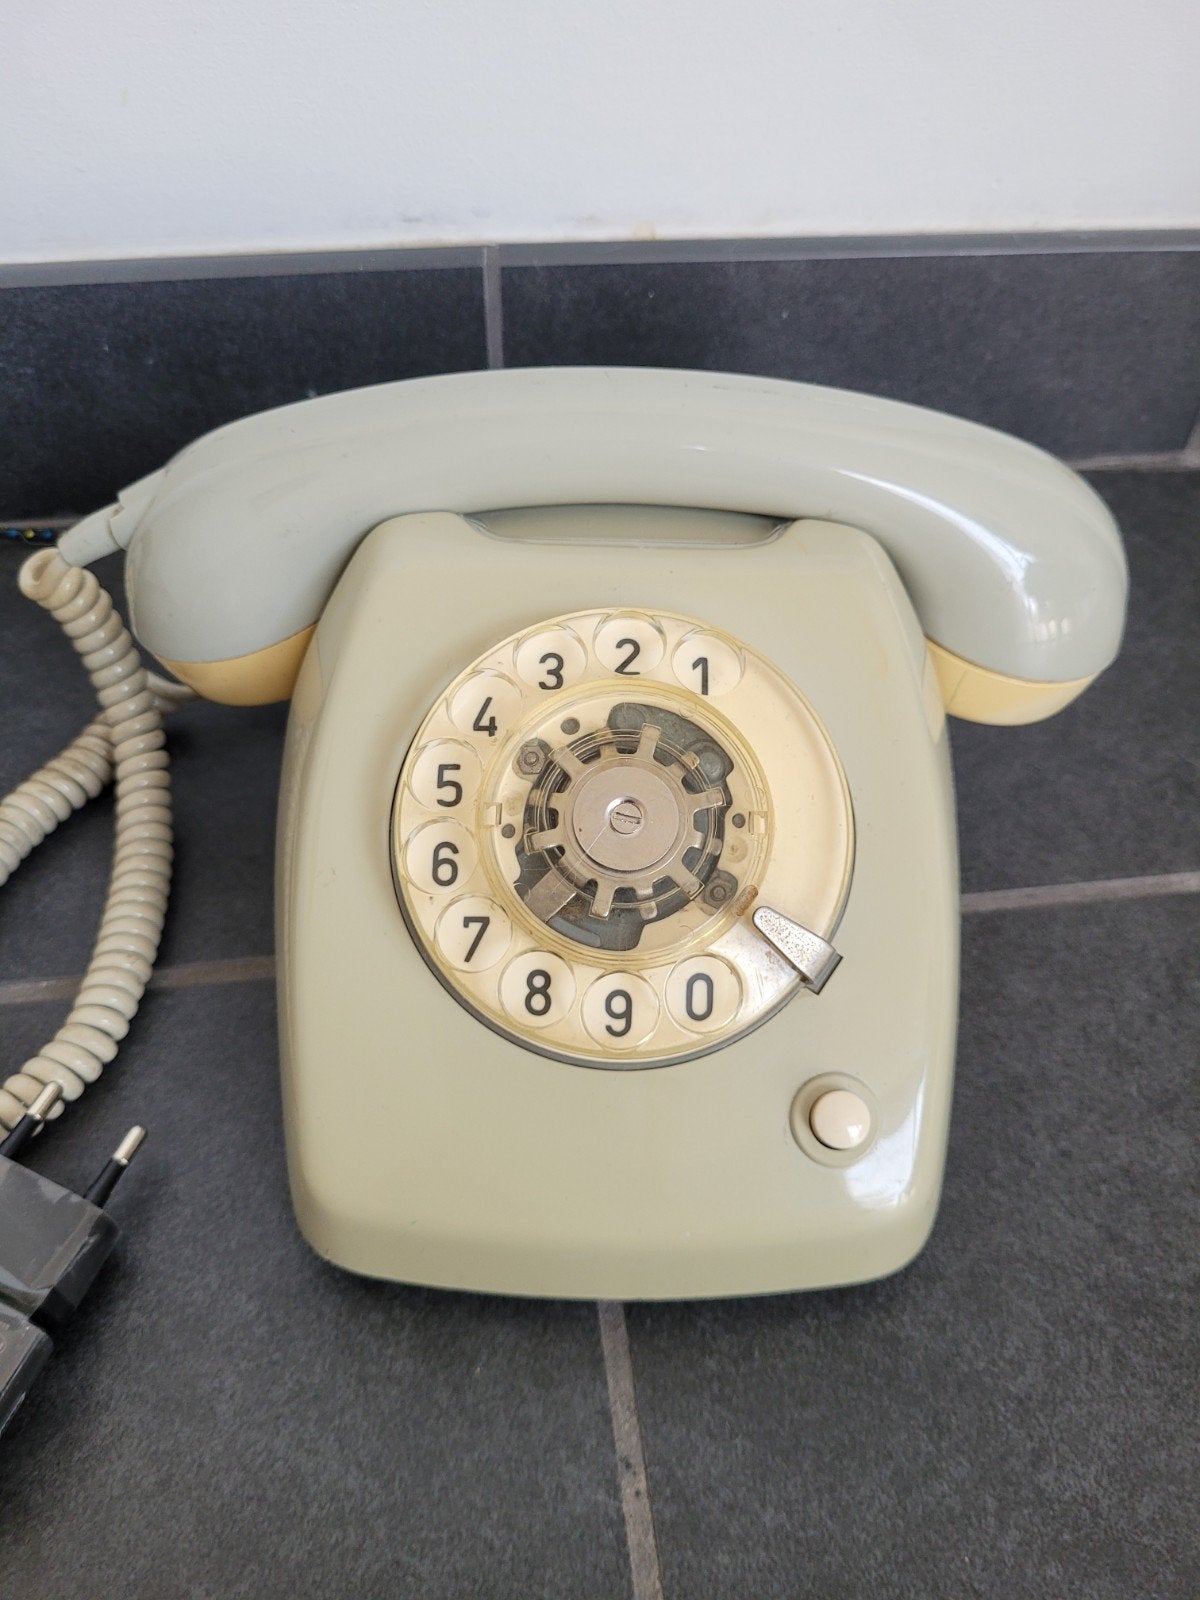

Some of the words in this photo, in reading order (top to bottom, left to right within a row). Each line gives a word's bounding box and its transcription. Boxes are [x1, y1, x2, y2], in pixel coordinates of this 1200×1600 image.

[538, 653, 563, 690] 3
[615, 639, 640, 675] 2
[692, 657, 709, 695] 1
[473, 697, 498, 737] 4
[437, 764, 463, 807] 5
[432, 842, 459, 886] 6
[463, 917, 490, 962] 7
[525, 969, 552, 1016] 8
[605, 990, 633, 1037] 9
[686, 973, 713, 1021] 0
